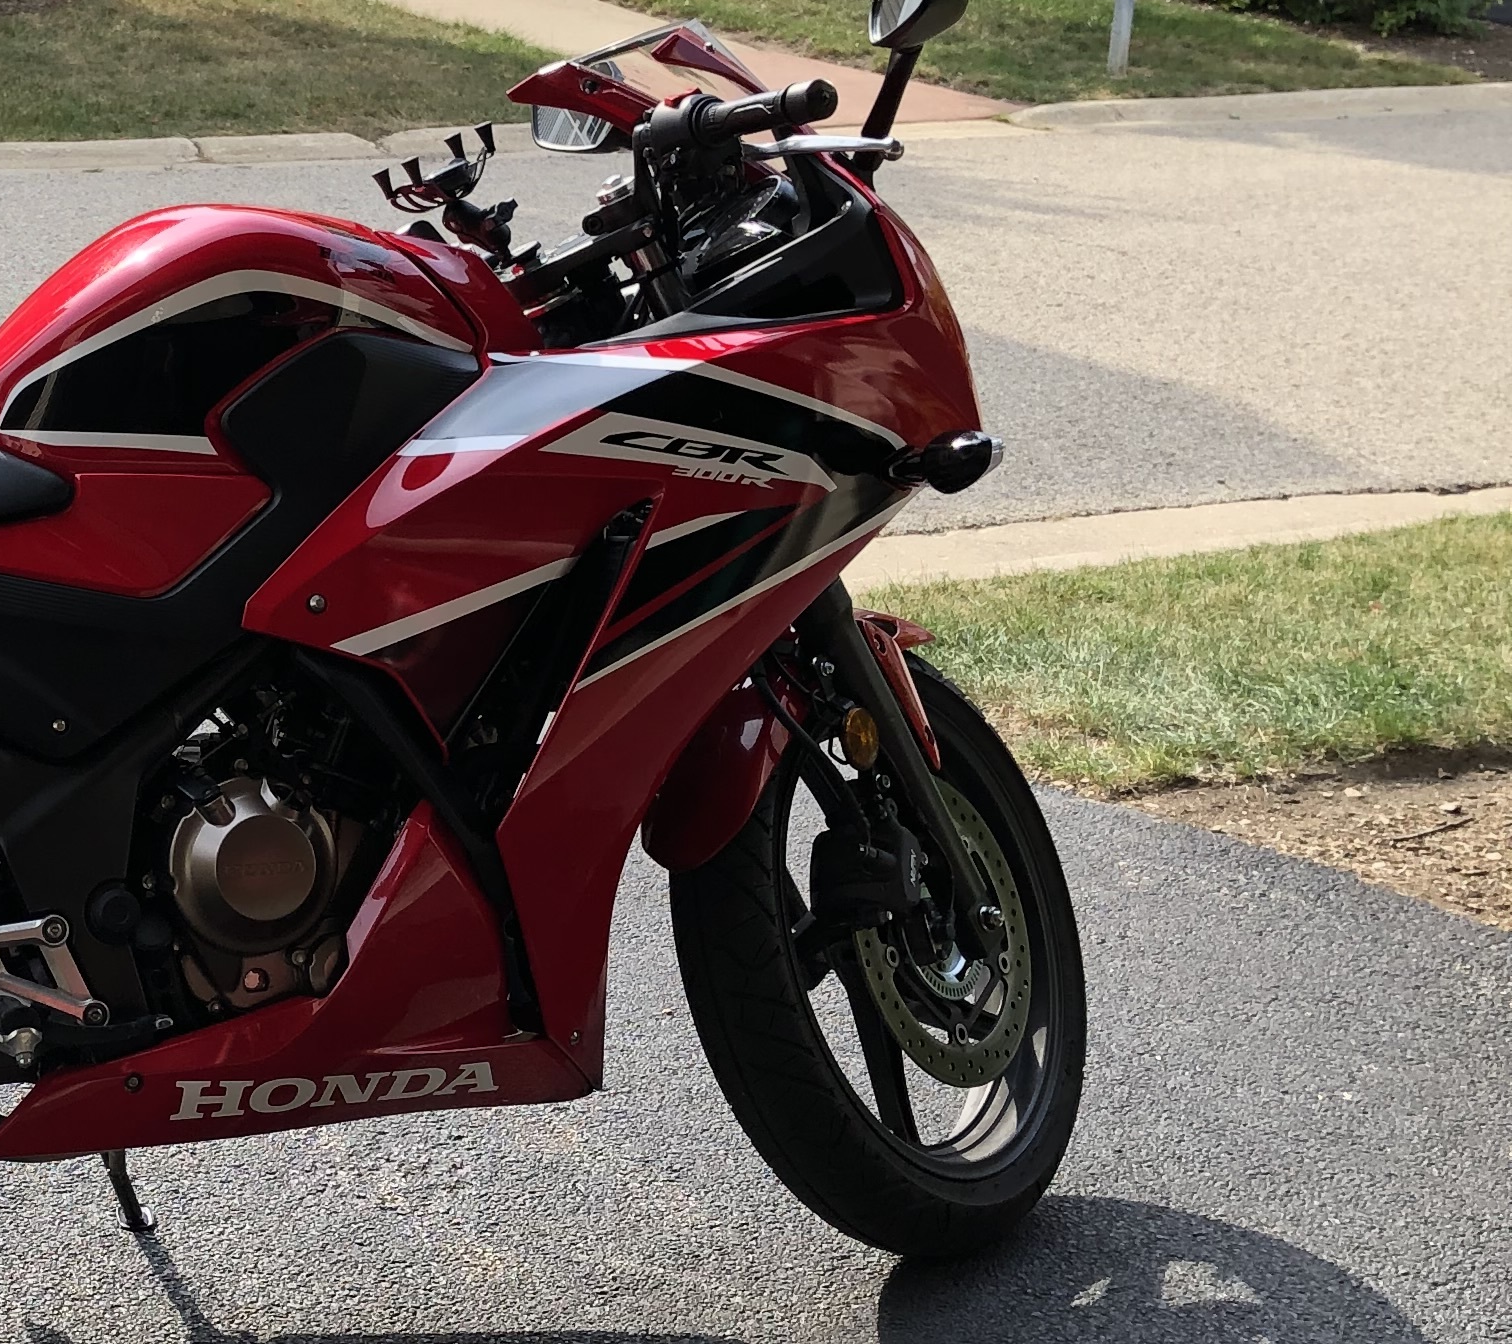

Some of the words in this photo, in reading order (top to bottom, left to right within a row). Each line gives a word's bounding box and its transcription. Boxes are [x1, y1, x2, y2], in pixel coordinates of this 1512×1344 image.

[599, 430, 789, 476] CBR
[672, 466, 774, 489] 300R
[169, 1061, 499, 1120] HONDA
